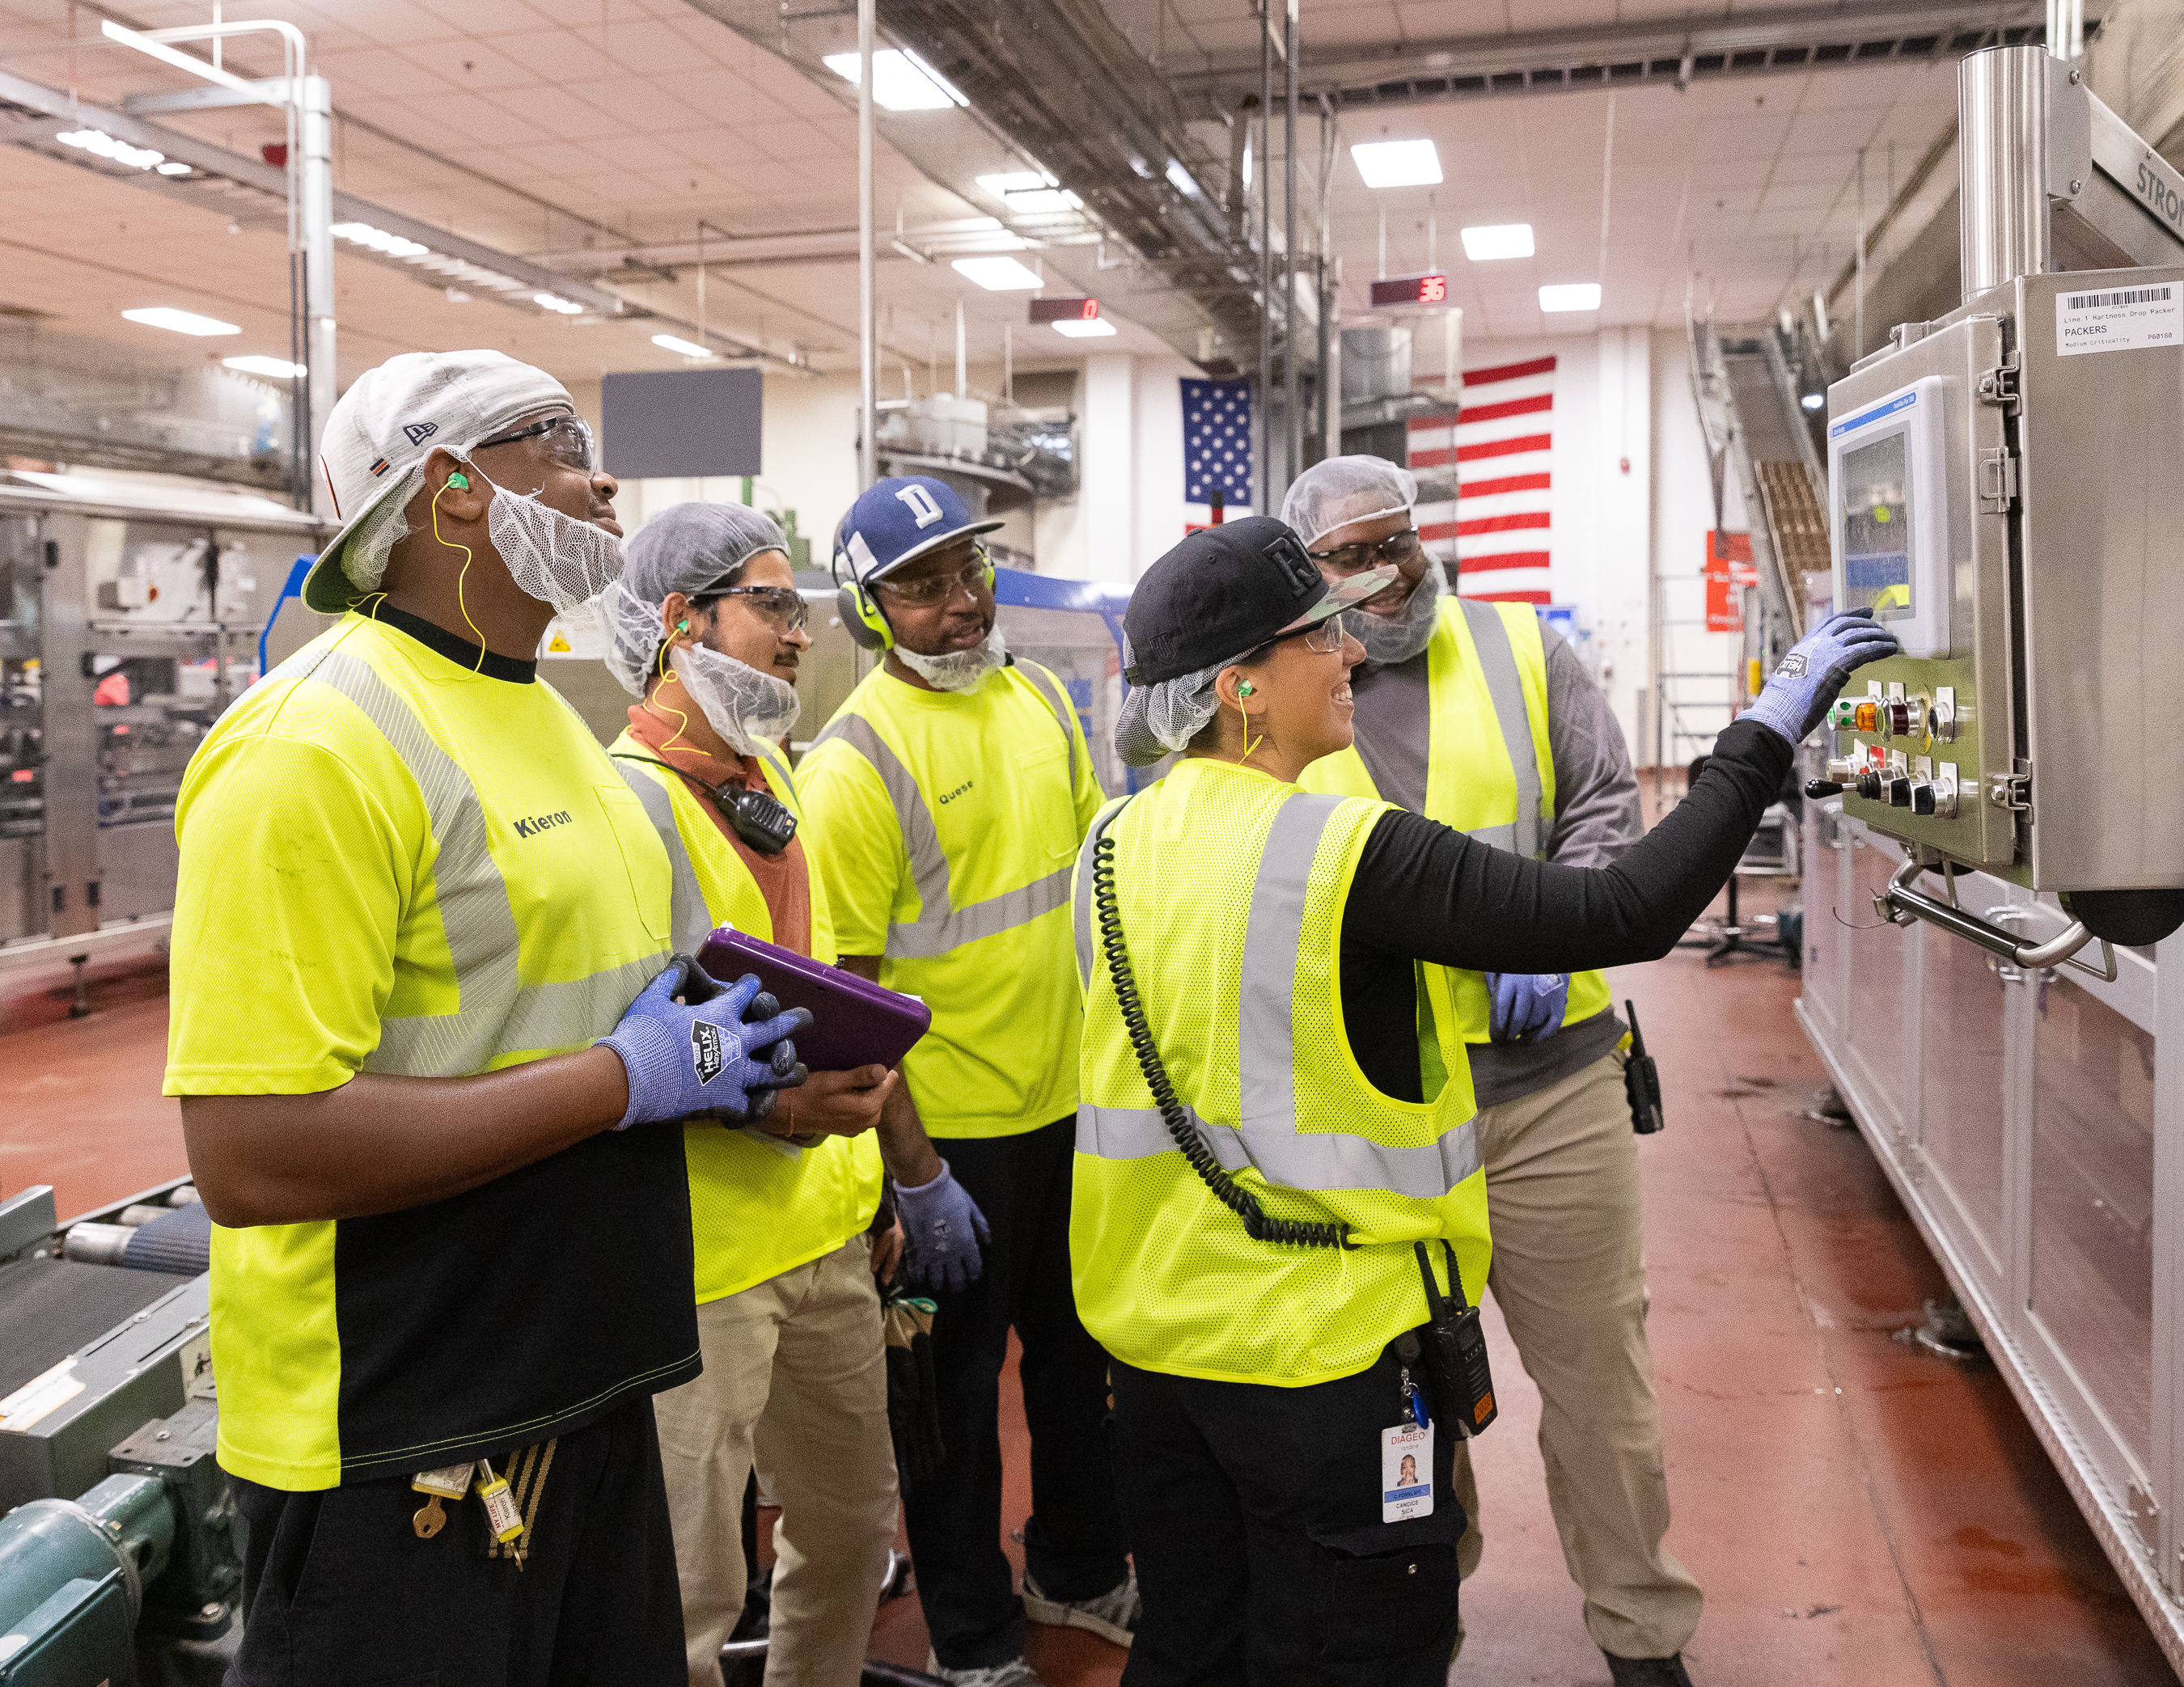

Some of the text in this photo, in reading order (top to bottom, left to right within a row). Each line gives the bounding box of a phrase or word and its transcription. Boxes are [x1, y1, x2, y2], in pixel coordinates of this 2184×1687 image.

[1418, 276, 1446, 302] 36
[1081, 298, 1098, 320] 0
[2064, 325, 2107, 336] PACKERS
[2090, 337, 2131, 345] Criticality
[2148, 332, 2173, 340] P60180
[895, 484, 943, 530] D
[939, 780, 973, 805] Quese
[513, 810, 573, 839] Kieron
[700, 1029, 713, 1073] HELIX
[1391, 1431, 1425, 1445] DIAGEO
[489, 1504, 497, 1519] LIFE
[501, 1497, 511, 1520] Kieron
[1396, 1500, 1419, 1509] CANDICE
[494, 1519, 501, 1528] MY
